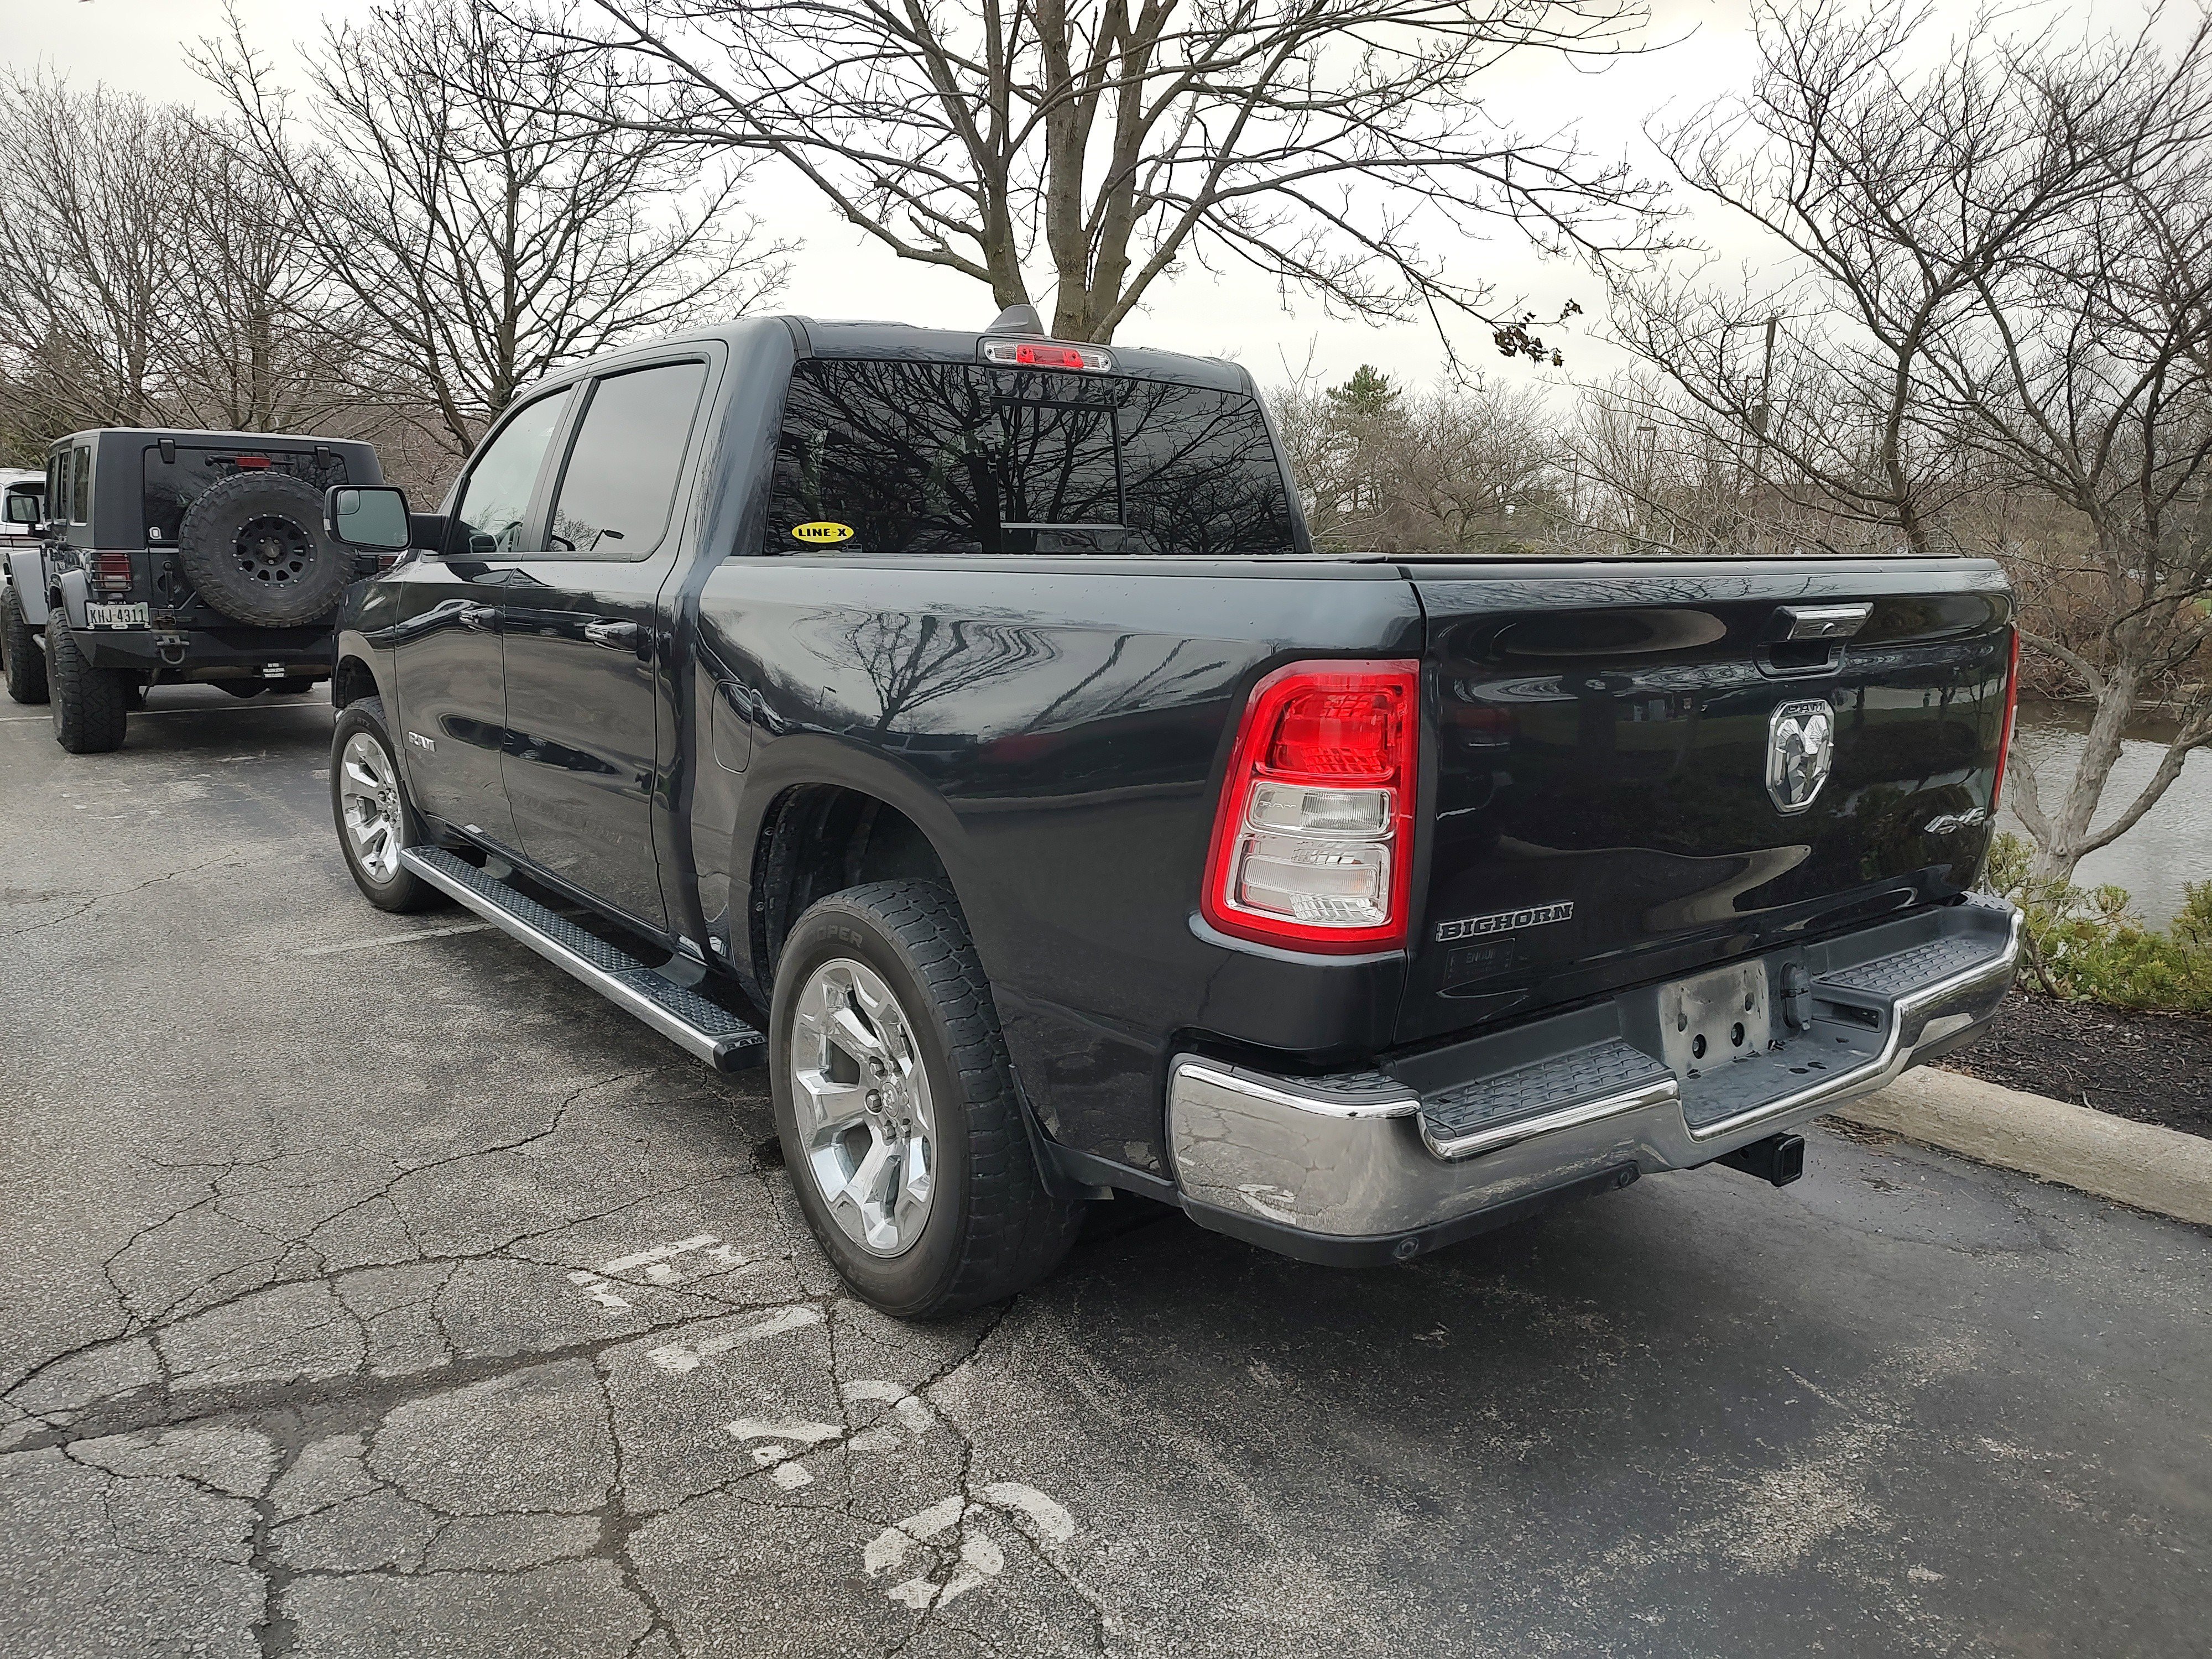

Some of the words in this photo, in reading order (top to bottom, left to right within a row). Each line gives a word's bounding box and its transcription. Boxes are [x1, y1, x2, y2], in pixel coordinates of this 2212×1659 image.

[798, 528, 848, 536] LINE-X
[90, 609, 112, 623] KHJ
[117, 609, 147, 623] 4311
[1787, 702, 1825, 714] RAM
